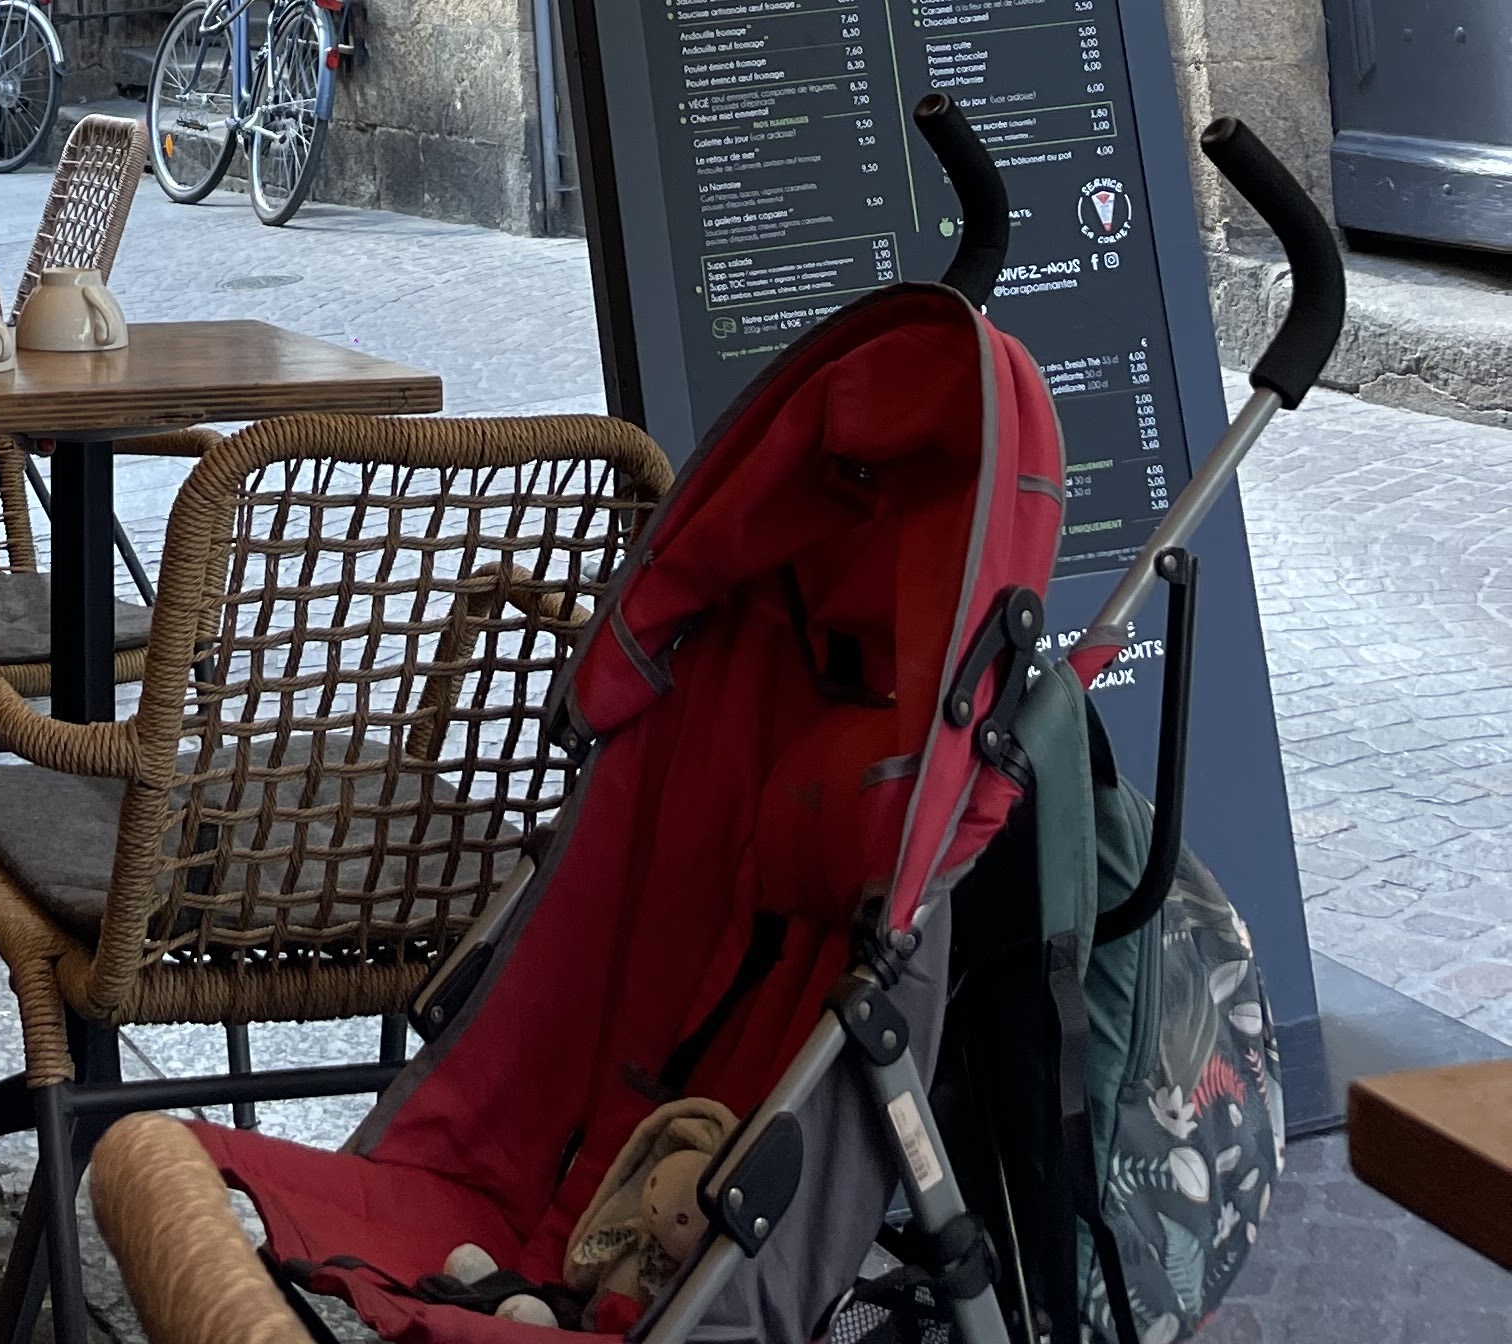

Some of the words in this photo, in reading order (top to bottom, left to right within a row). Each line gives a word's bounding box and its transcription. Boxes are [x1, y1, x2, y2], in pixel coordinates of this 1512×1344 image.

[855, 118, 873, 129] 9,50
[722, 135, 733, 144] du
[734, 135, 748, 144] jour
[858, 135, 875, 145] 9,50
[1081, 177, 1124, 196] SERVICE
[1097, 221, 1132, 244] CORNET
[995, 259, 1081, 282] UIVEZ-NOUS
